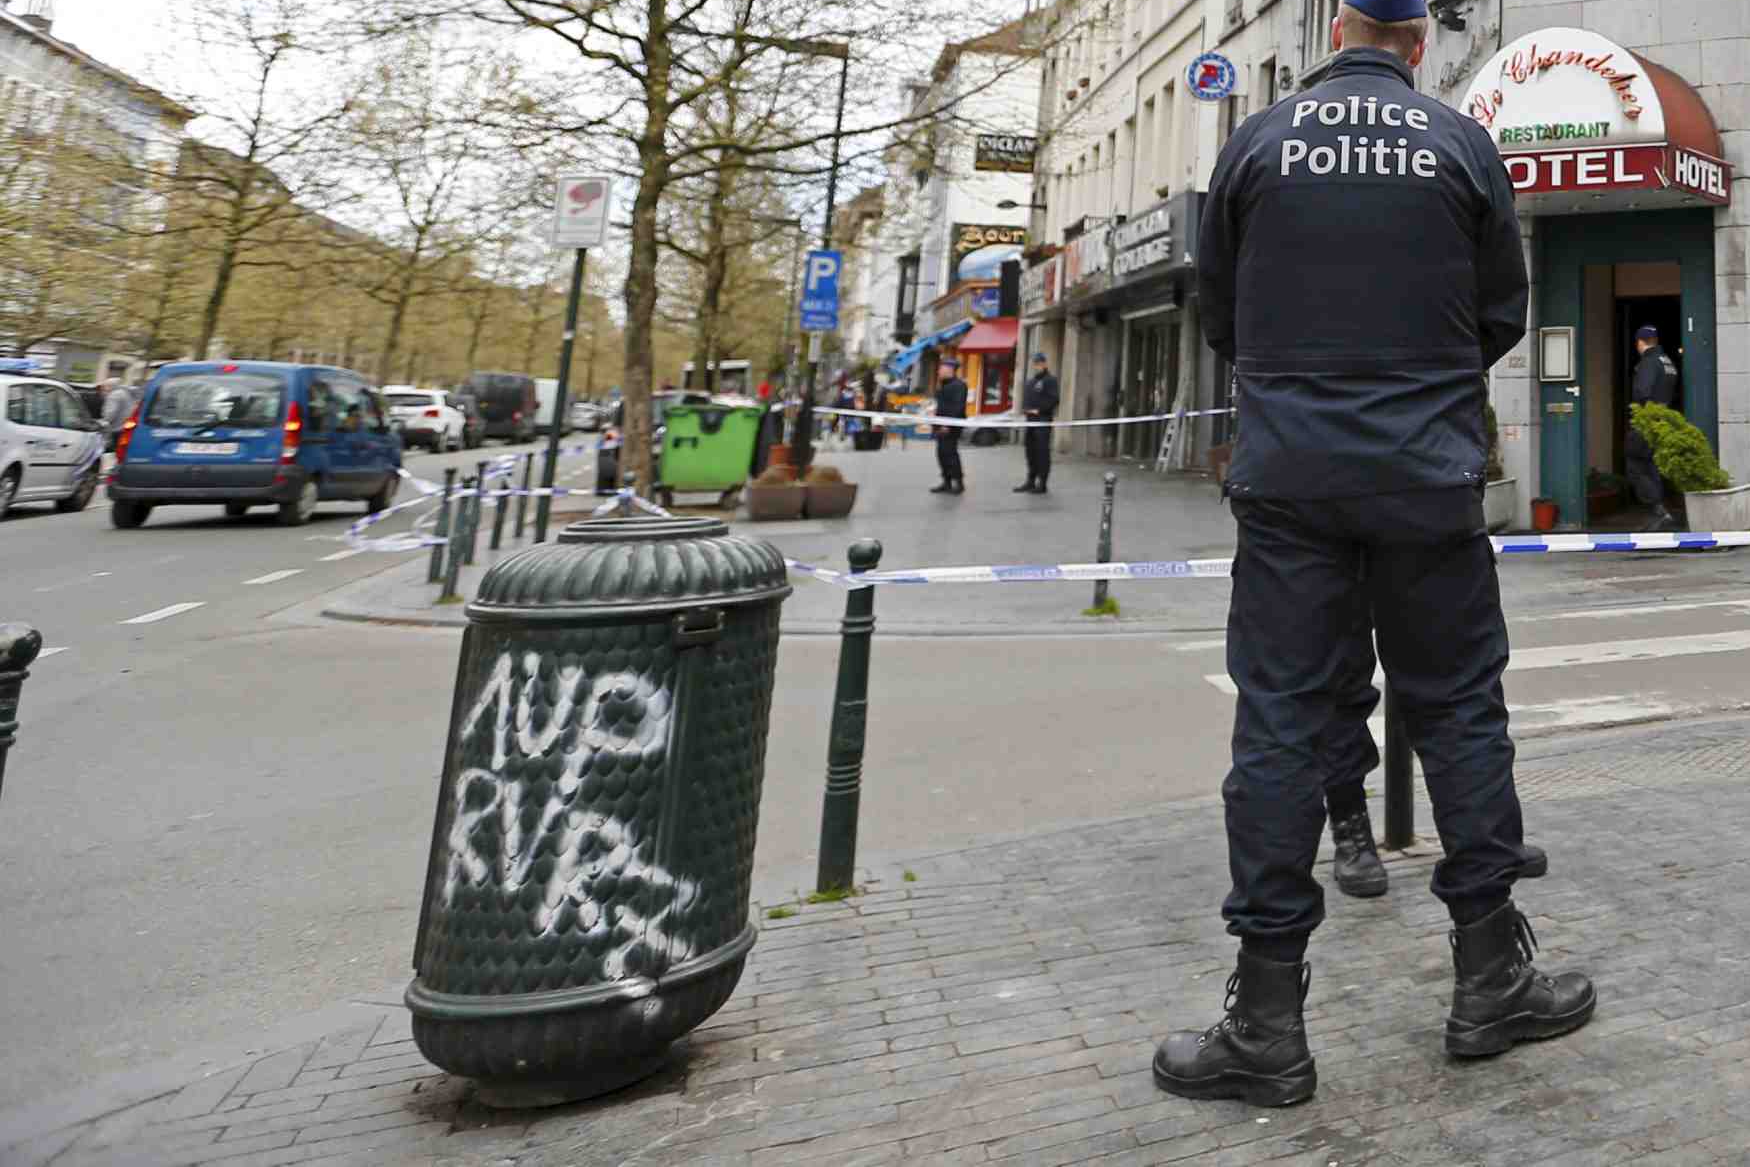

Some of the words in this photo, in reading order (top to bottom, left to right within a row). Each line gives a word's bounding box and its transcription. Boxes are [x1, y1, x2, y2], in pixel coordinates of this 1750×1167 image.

[1292, 96, 1429, 130] Police
[1501, 121, 1610, 143] RESTAURANT
[1281, 135, 1437, 177] Politie
[1505, 150, 1643, 189] OTEL
[1675, 150, 1727, 197] HOTEL
